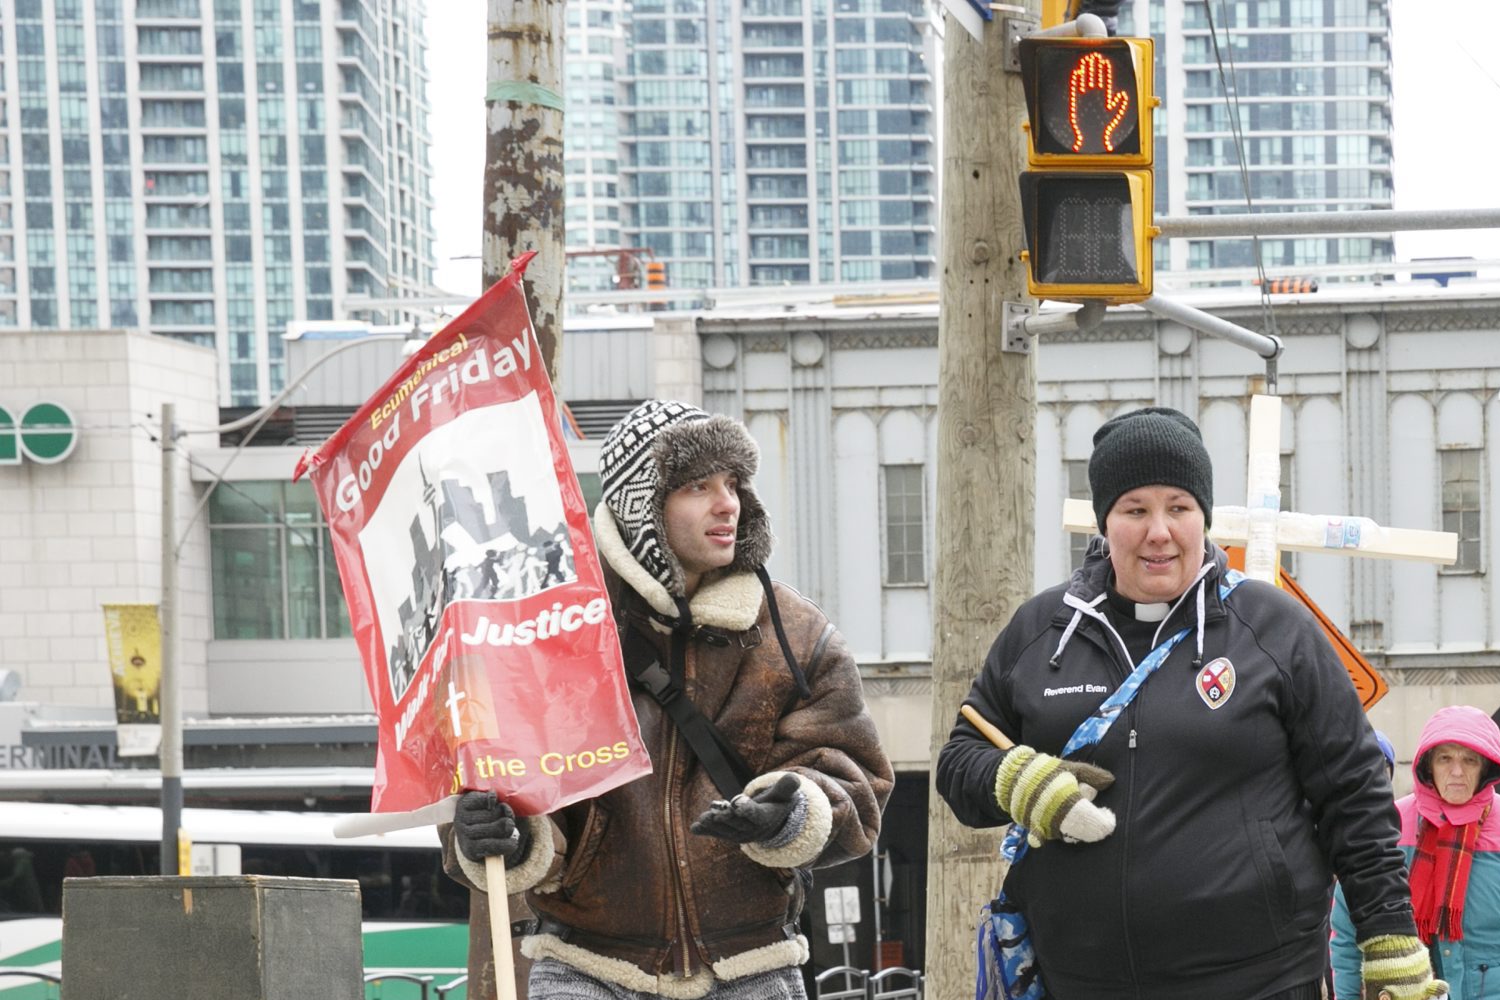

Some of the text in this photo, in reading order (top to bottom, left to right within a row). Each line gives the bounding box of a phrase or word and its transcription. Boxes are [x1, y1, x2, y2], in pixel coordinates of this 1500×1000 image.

[369, 333, 469, 430] Ecumenical
[335, 327, 531, 512] Good Friday
[461, 597, 607, 648] Justice
[1043, 684, 1107, 697] Reverend Evan
[475, 755, 527, 779] the
[540, 740, 630, 776] Cross
